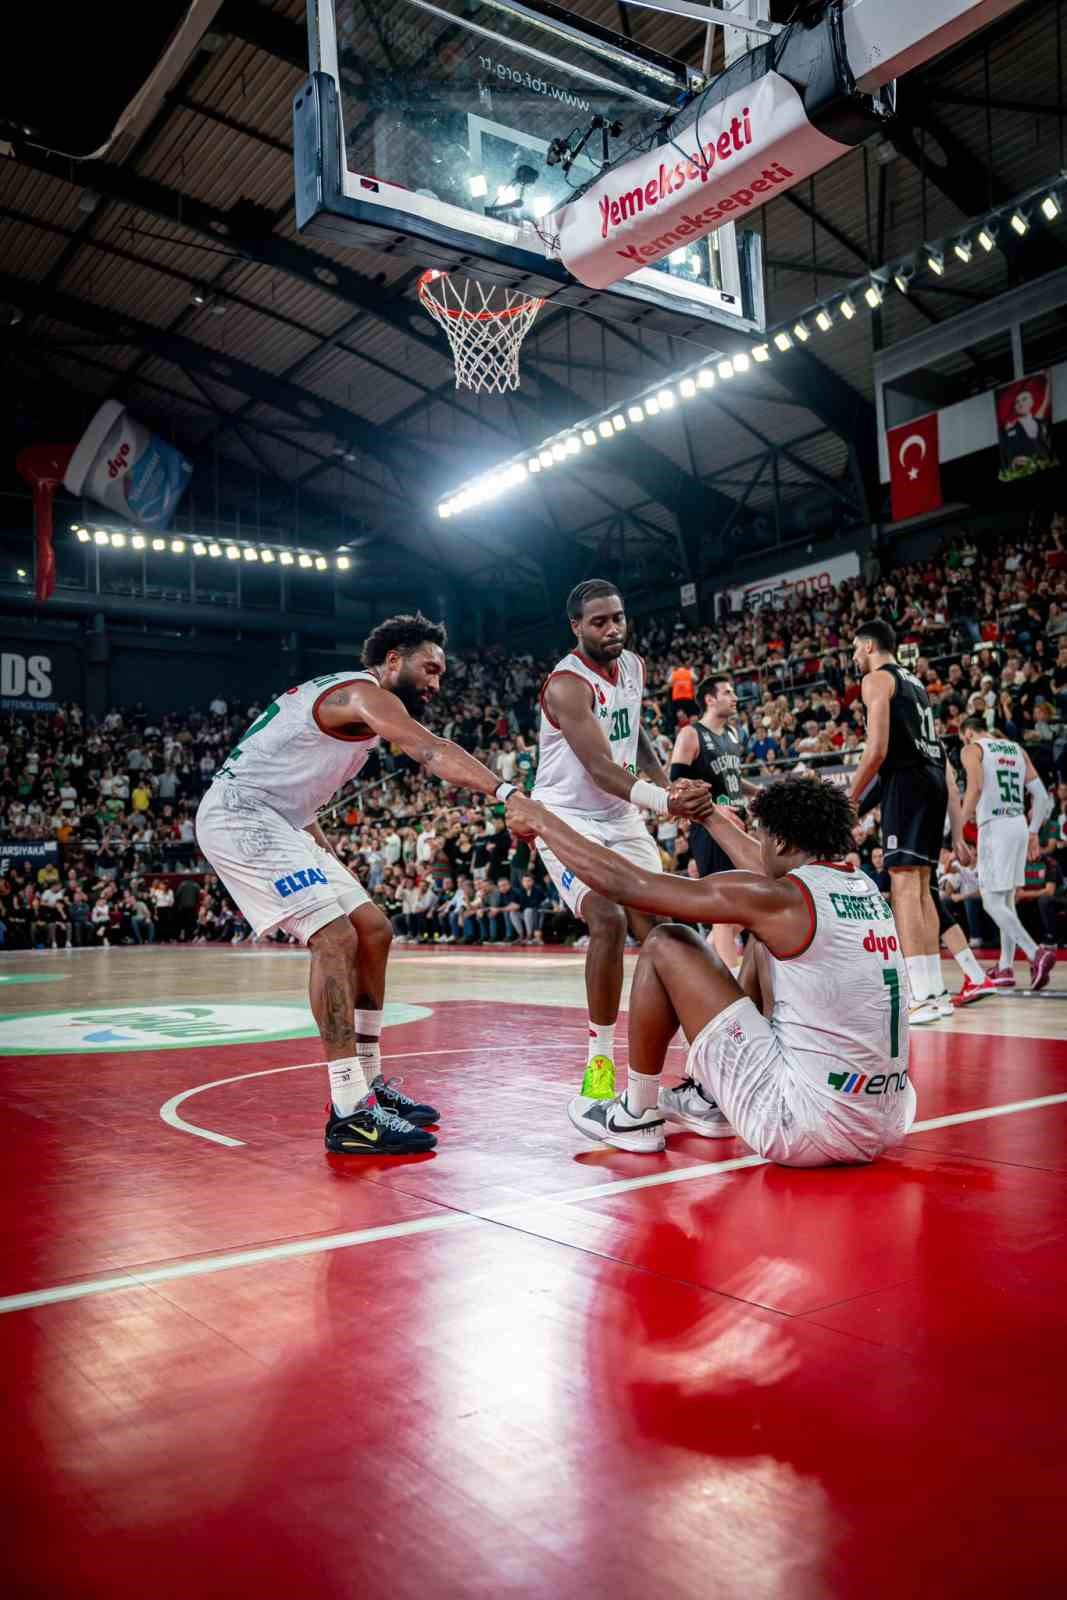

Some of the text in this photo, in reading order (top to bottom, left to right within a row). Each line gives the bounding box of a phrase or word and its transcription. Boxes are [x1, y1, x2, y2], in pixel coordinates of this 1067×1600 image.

[599, 107, 753, 238] Yemeksepeti
[616, 162, 794, 265] Yemeksepeti
[107, 443, 130, 479] dyo
[1, 653, 52, 699] DS
[609, 707, 632, 742] 30
[996, 769, 1022, 804] 55
[863, 929, 897, 960] dyo
